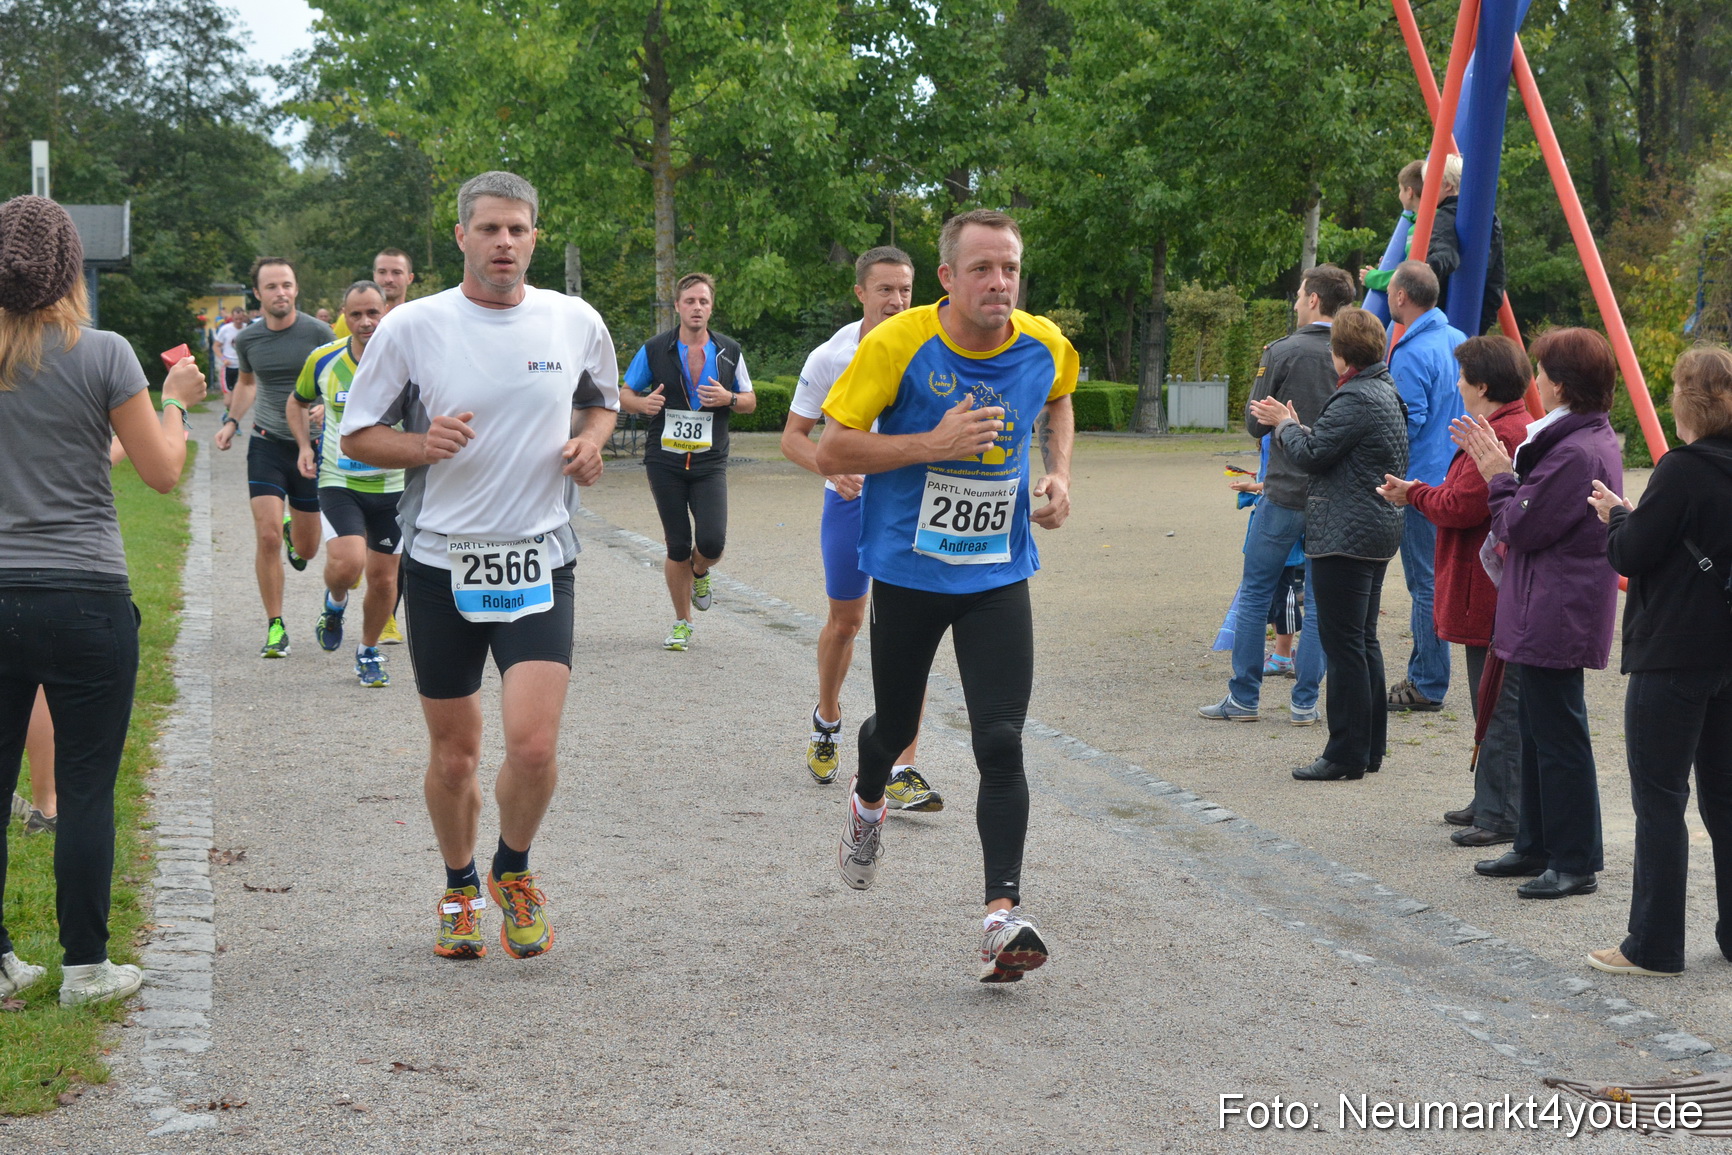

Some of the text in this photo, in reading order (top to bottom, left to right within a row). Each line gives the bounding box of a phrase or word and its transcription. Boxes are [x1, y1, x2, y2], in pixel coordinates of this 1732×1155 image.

[673, 421, 703, 440] 338
[927, 480, 1007, 498] PARTL Neumarkt
[929, 496, 1010, 533] 2865
[939, 537, 988, 553] Andreas
[462, 548, 542, 586] 2566
[482, 593, 525, 609] Roland
